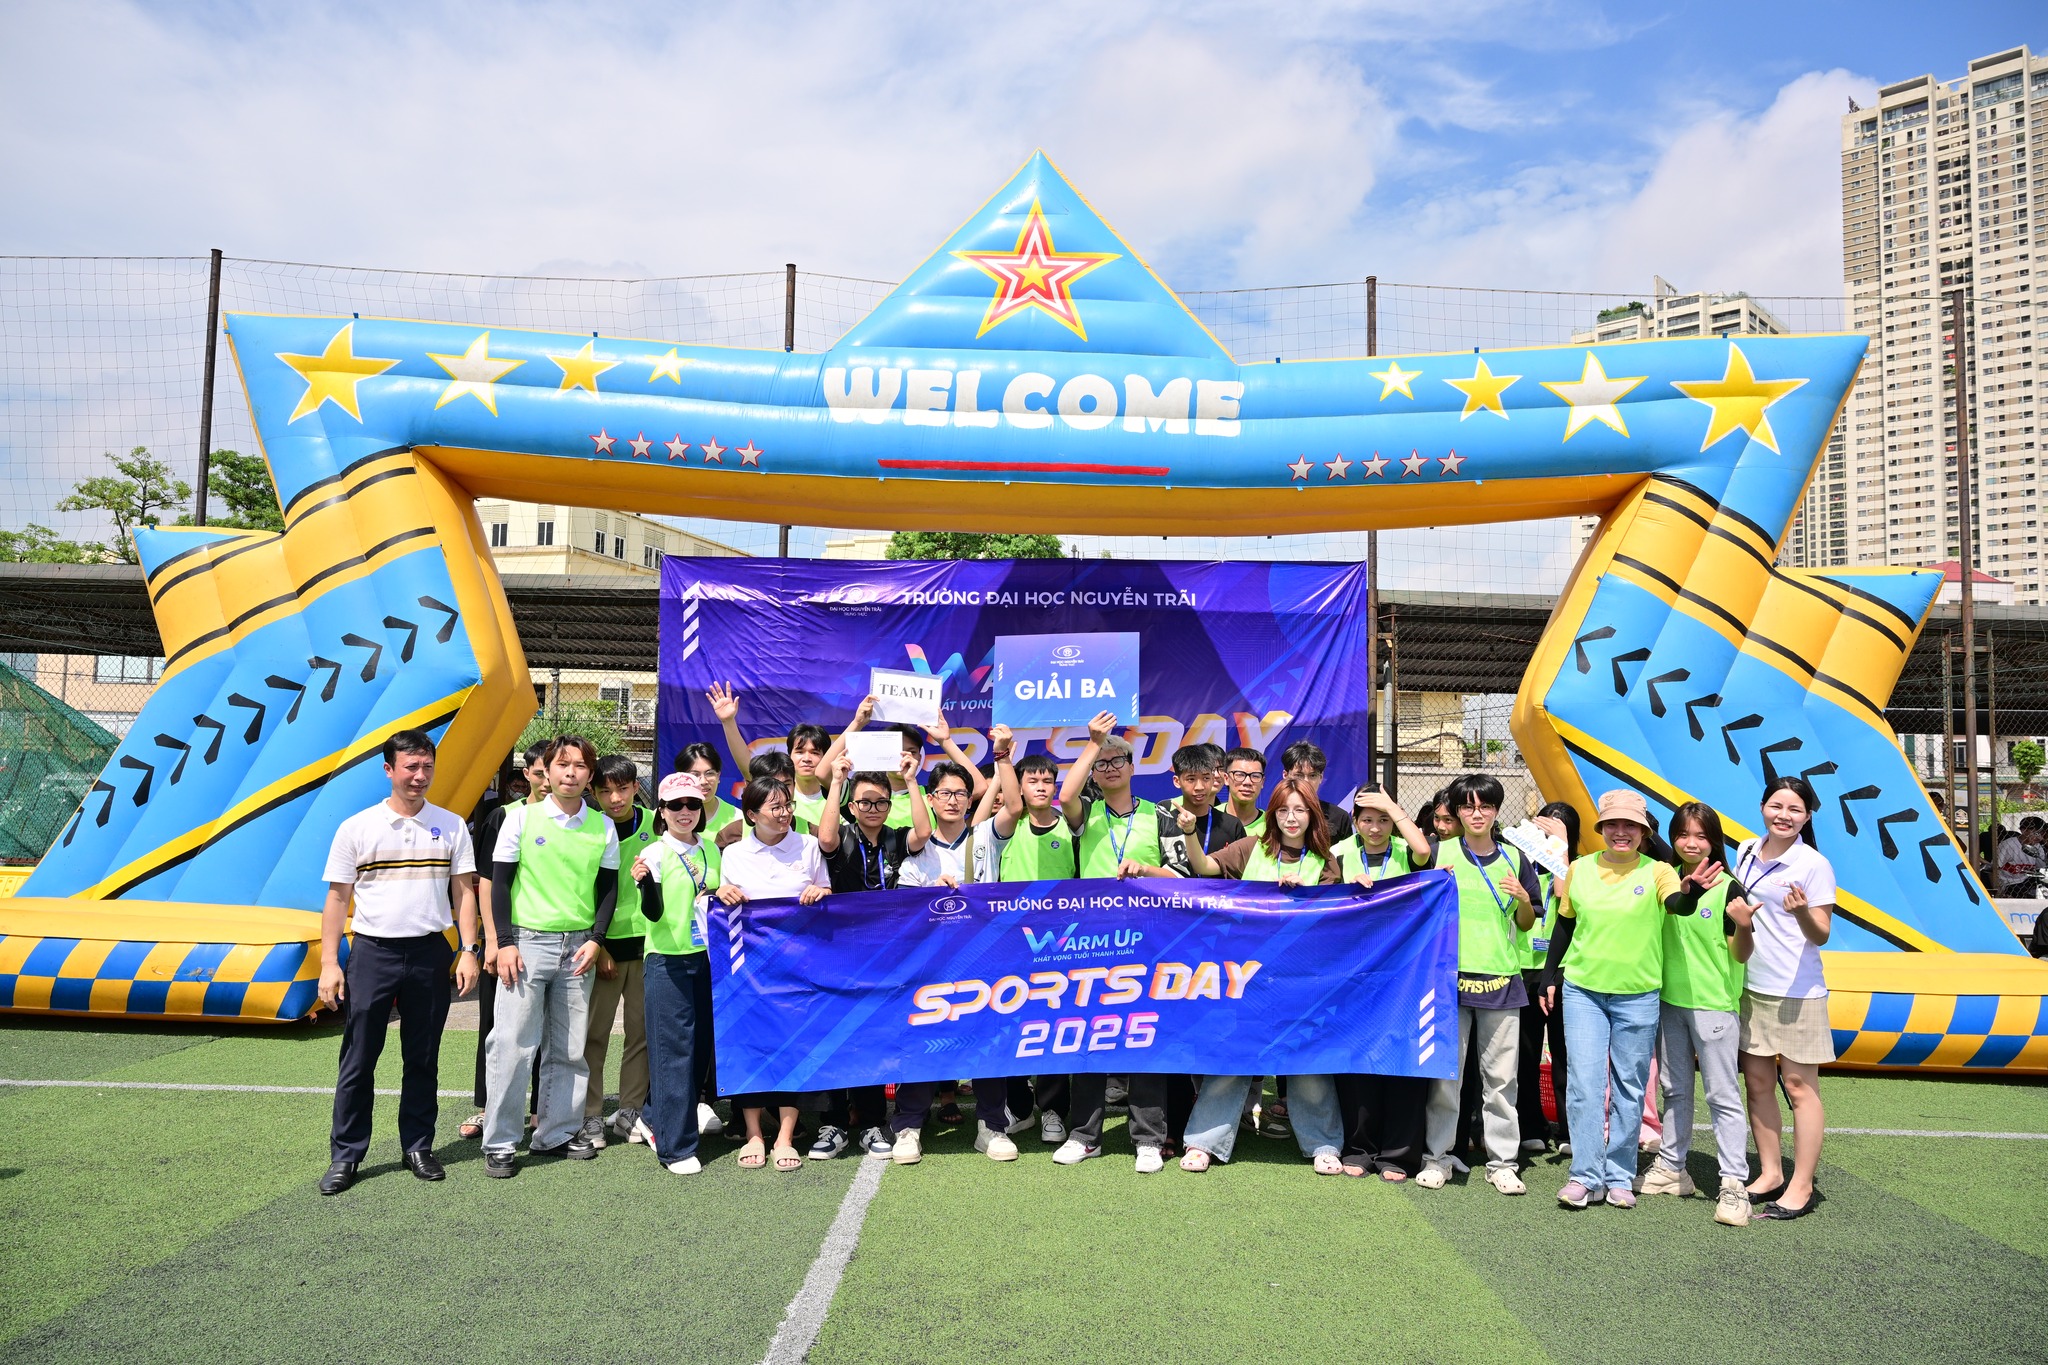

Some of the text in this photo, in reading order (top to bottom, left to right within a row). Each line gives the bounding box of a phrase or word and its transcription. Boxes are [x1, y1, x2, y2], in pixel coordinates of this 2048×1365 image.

[823, 366, 1245, 437] WELCOME
[904, 586, 1196, 608] TRƯỜNG ĐẠI HỌC NGUYỄN TRÃI
[878, 683, 934, 701] TEAM 1
[1014, 672, 1117, 700] GIẢI BA
[987, 891, 1234, 913] TRƯỜNG ĐẠI HỌC NGUYỄN TRÃI
[1033, 953, 1052, 963] KHÁT
[1053, 954, 1072, 962] VỌNG
[1092, 950, 1115, 958] THANH
[1116, 948, 1135, 956] XUÂN
[907, 960, 1263, 1026] SPORTS DAY
[1015, 1011, 1160, 1058] 2025
